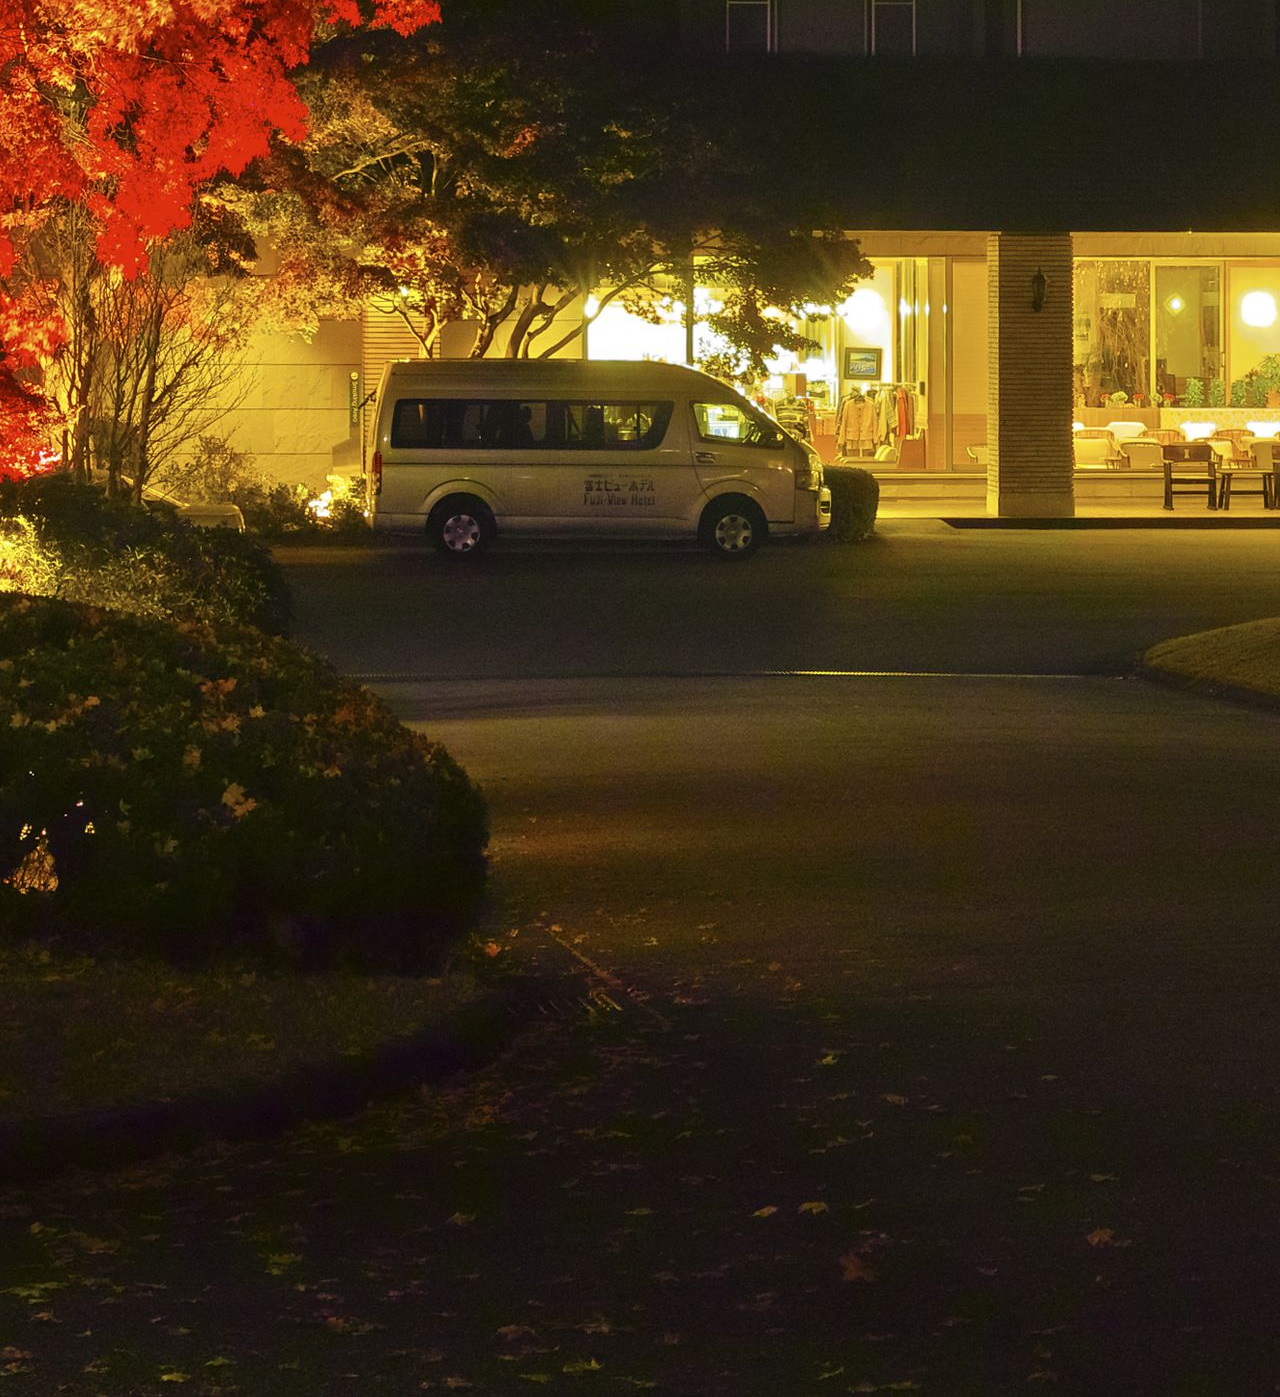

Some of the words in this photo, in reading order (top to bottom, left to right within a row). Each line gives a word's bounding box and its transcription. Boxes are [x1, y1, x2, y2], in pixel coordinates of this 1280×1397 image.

[351, 381, 359, 407] Smoking
[584, 479, 656, 492] 富士ビューホテル
[631, 492, 656, 506] Hotel
